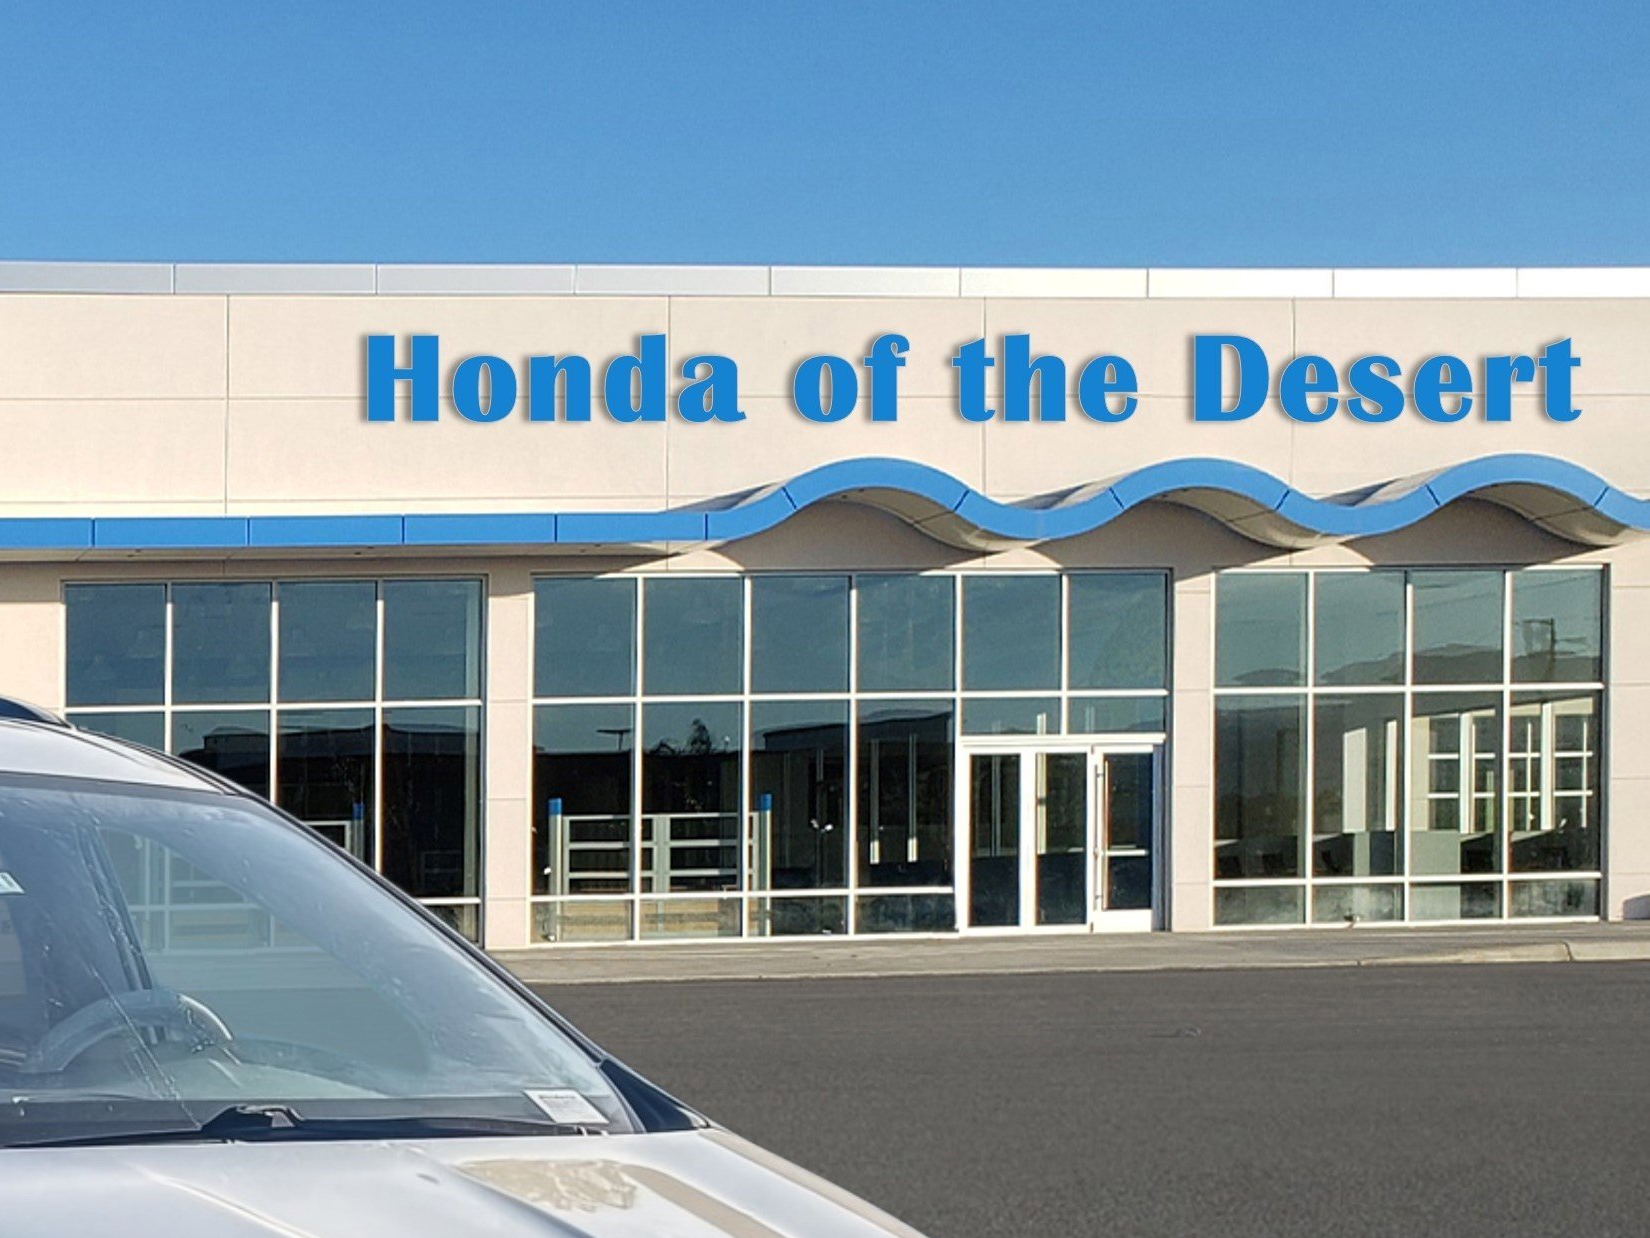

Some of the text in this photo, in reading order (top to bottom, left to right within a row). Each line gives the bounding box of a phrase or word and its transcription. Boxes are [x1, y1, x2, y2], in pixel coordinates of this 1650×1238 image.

[366, 333, 1583, 424] Honda of the Desert
